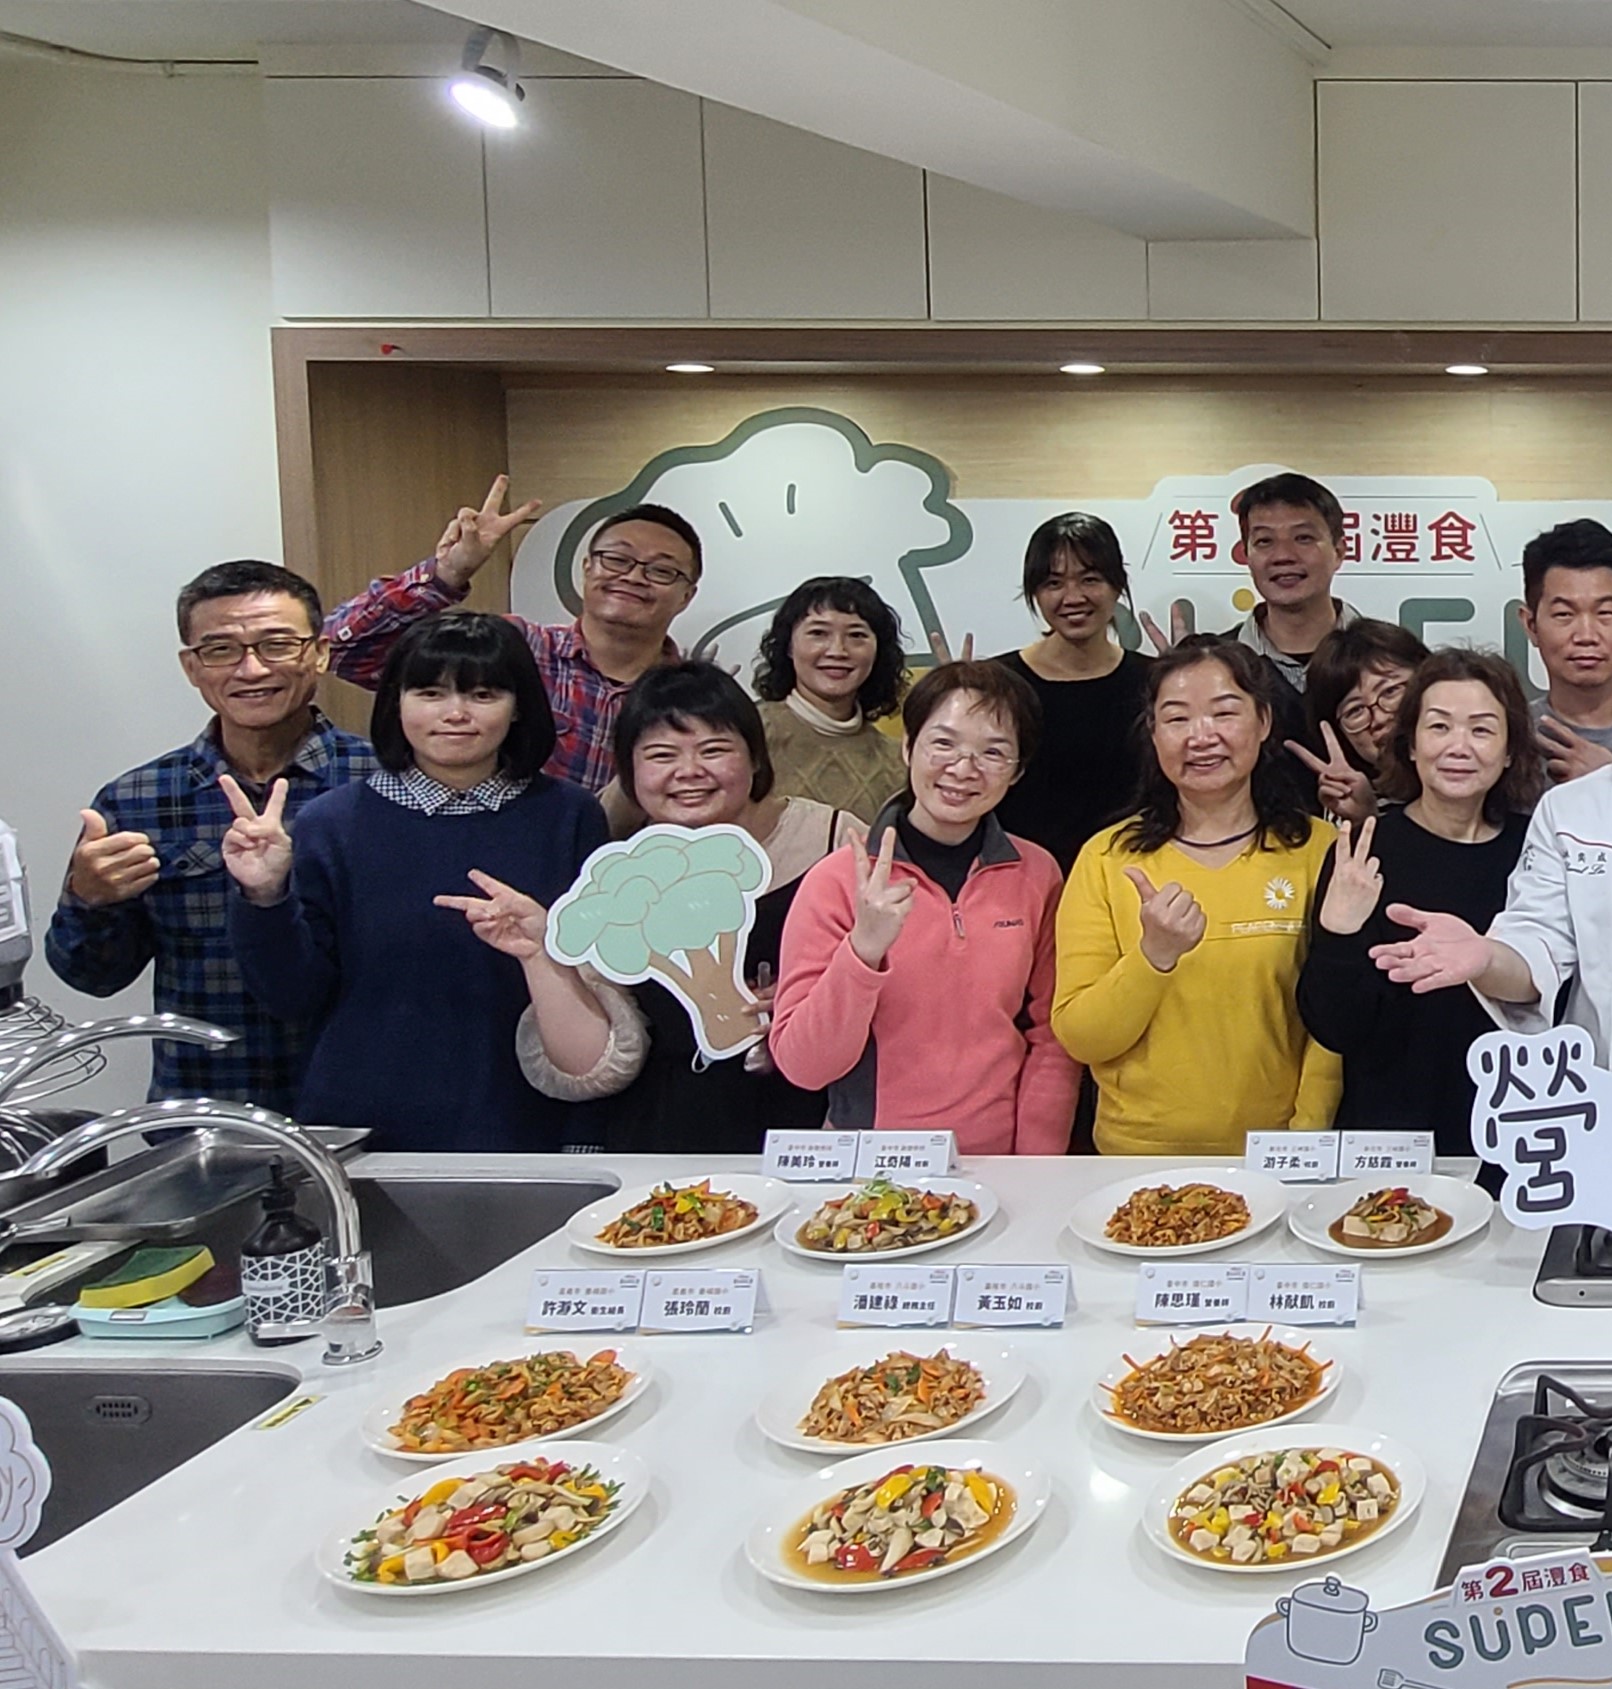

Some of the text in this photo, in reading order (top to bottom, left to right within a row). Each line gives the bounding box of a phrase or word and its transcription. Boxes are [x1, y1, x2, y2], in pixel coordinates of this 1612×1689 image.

[1168, 491, 1477, 565] 第灃食
[1461, 1562, 1591, 1602] 第2屆灃食
